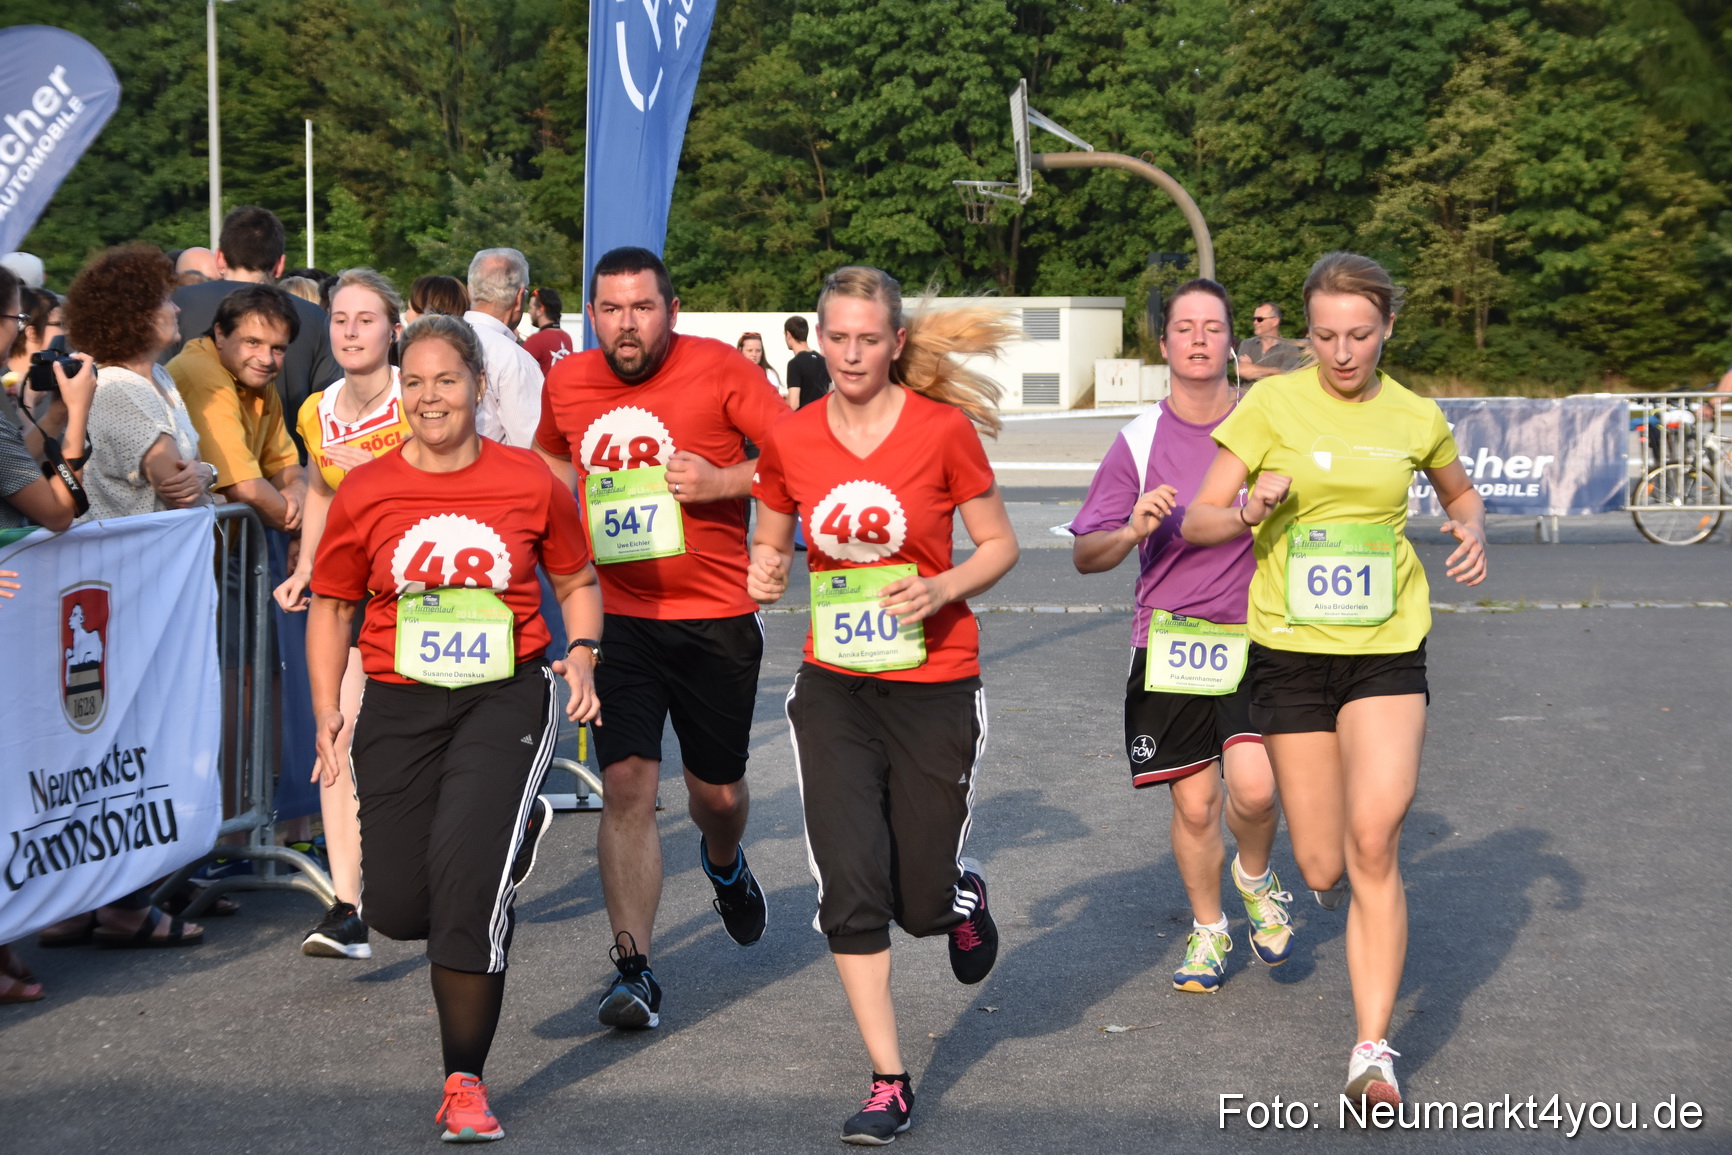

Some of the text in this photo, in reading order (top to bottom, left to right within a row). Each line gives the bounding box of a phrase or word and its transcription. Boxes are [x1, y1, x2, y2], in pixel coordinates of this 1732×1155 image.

[57, 463, 79, 491] SONY
[1408, 484, 1540, 498] AUOBILE
[605, 504, 658, 537] 547
[630, 540, 650, 548] Eichler
[1307, 565, 1371, 597] 661
[834, 609, 898, 645] 540
[420, 631, 490, 664] 544
[838, 648, 899, 658] Annika Engelmann
[1168, 641, 1228, 671] 506
[422, 670, 453, 678] Susanne
[1180, 674, 1223, 683] Auernhammer
[73, 696, 96, 718] 1628
[1132, 746, 1153, 757] FCN
[28, 743, 147, 814] Neumkter
